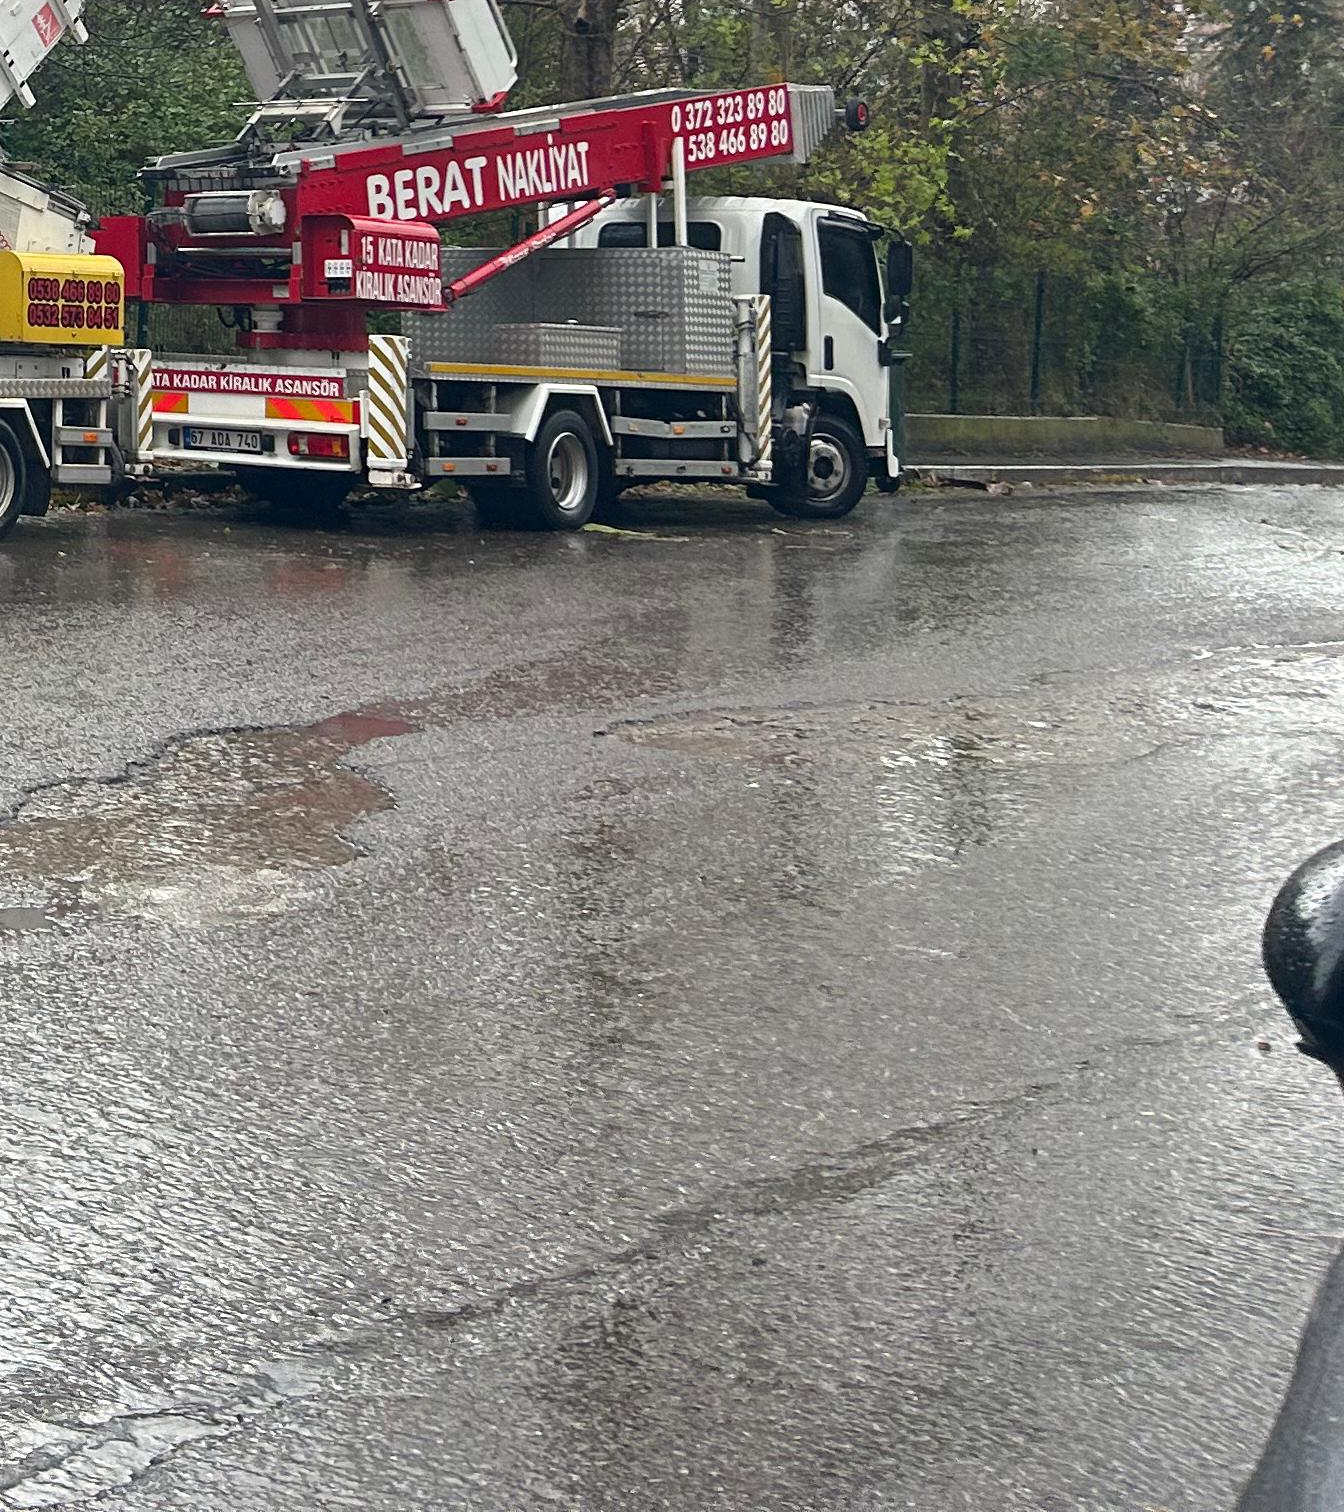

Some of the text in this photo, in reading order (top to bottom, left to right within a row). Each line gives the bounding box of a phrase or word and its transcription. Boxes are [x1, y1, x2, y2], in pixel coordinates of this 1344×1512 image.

[672, 88, 785, 133] 0 372 323 89 80
[687, 118, 788, 162] 538 466 89 80
[366, 133, 589, 220] BERAT NAKLİYAT
[361, 235, 439, 271] 15 KATA KADAR
[27, 277, 121, 305] 0538 466 89 80
[396, 272, 442, 306] ASANSÖR
[27, 302, 60, 327] 0532
[103, 306, 120, 330] 51
[173, 373, 217, 390] KADAR
[220, 374, 272, 393] KİRALIK
[275, 378, 340, 397] ASANSÖR
[191, 430, 204, 444] 67
[237, 433, 258, 449] 740
